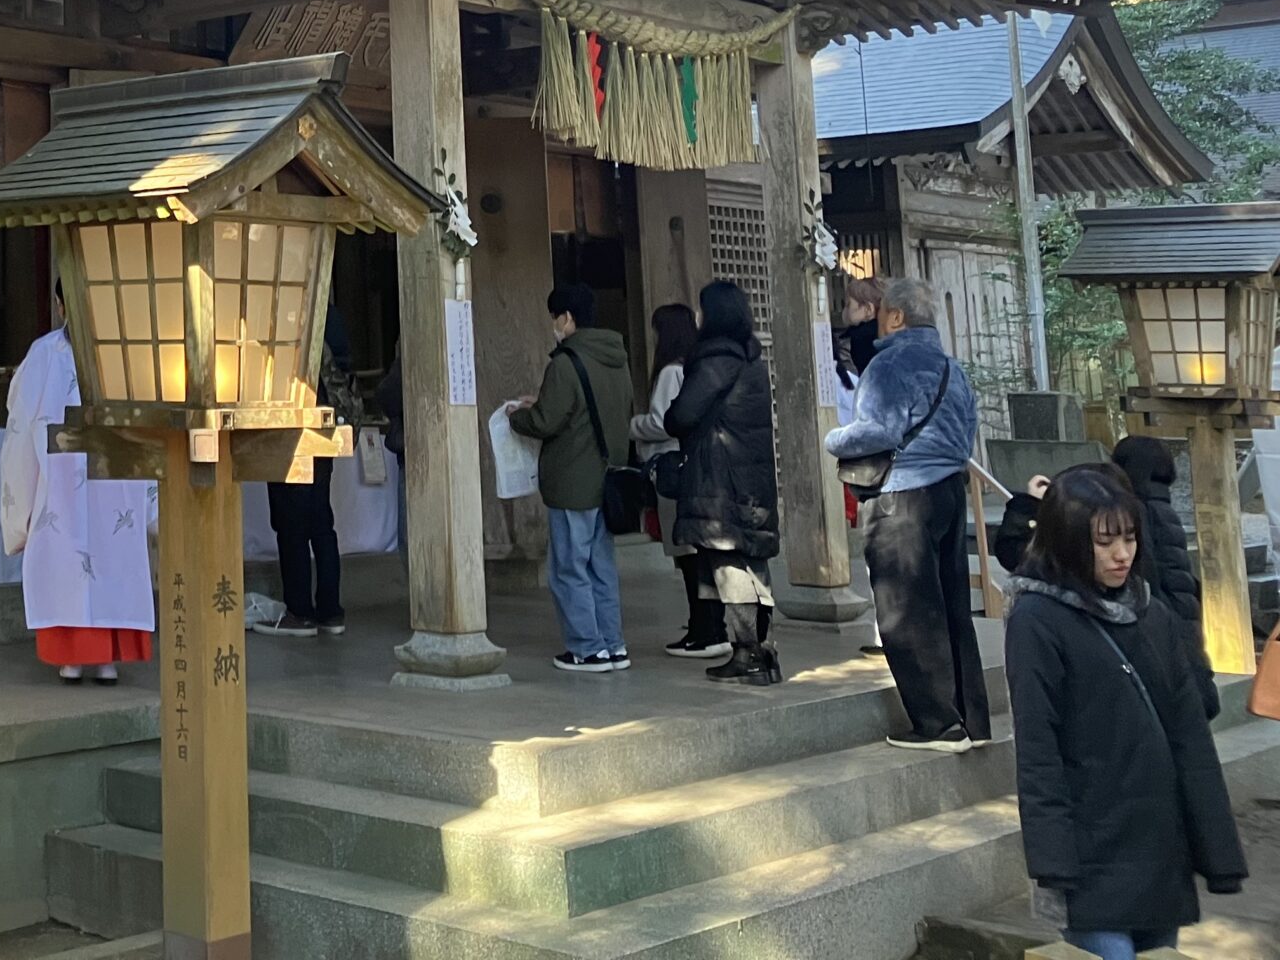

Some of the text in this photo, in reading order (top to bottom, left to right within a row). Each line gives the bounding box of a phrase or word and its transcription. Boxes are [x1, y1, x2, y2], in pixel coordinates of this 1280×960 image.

[172, 573, 189, 762] 平成六年四月十六日
[212, 574, 240, 687] 奉納
